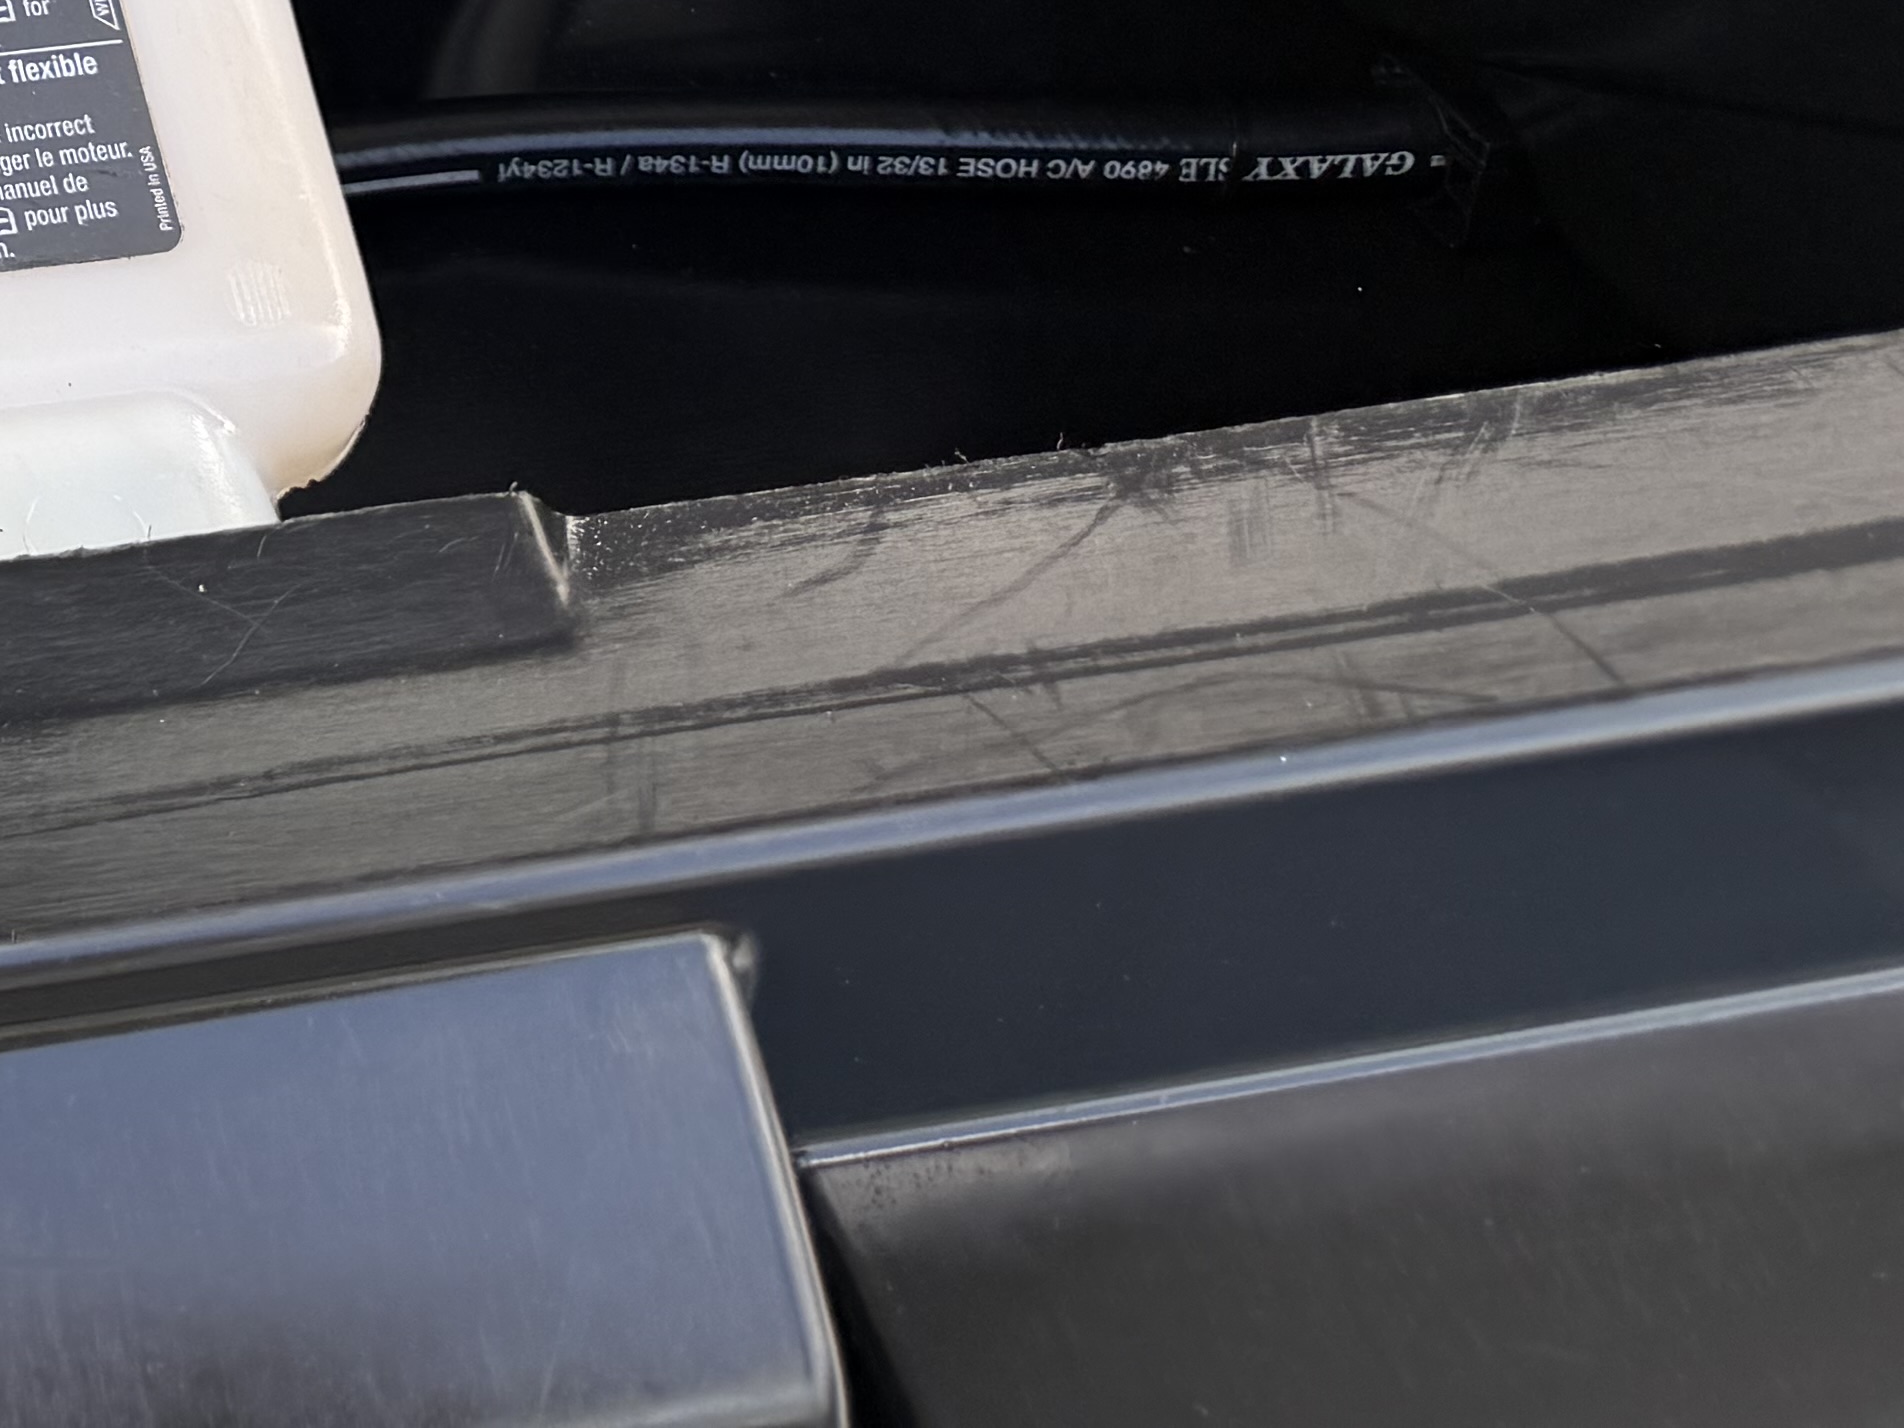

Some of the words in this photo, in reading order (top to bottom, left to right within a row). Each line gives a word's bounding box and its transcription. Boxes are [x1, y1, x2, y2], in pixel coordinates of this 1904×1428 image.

[9, 54, 97, 82] flexible
[6, 115, 95, 142] incorrect
[36, 148, 54, 167] le
[59, 138, 132, 164] moteur.
[139, 145, 156, 170] USA
[637, 153, 730, 175] R-134a
[738, 151, 839, 175] (10mm)
[847, 154, 871, 175] in
[878, 156, 948, 178] 13/32
[958, 158, 1040, 179] HOSE
[1047, 159, 1093, 179] A/C
[1244, 150, 1415, 182] GALAXY
[63, 173, 88, 193] de
[25, 207, 69, 232] pour
[74, 199, 117, 225] plus
